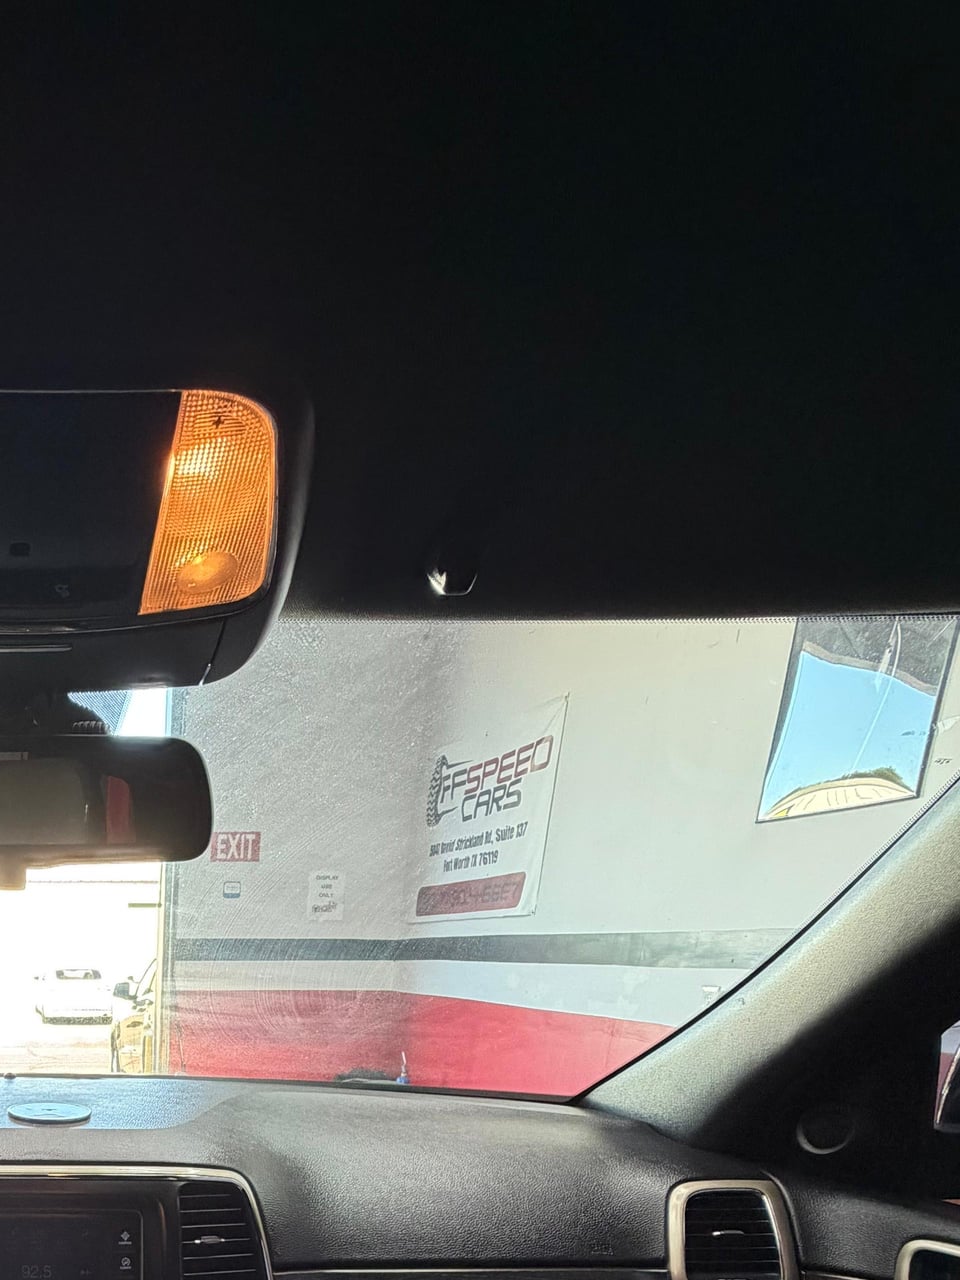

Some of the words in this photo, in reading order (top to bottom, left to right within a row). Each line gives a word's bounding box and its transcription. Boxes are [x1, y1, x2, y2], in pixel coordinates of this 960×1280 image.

[461, 777, 522, 822] CARS
[216, 834, 256, 859] EXIT
[455, 832, 484, 852] Strickland
[495, 825, 515, 842] Suite
[515, 821, 529, 838] 137
[443, 858, 453, 872] Fort
[453, 856, 470, 870] Worth
[470, 854, 478, 868] TX
[479, 850, 499, 866] 76119
